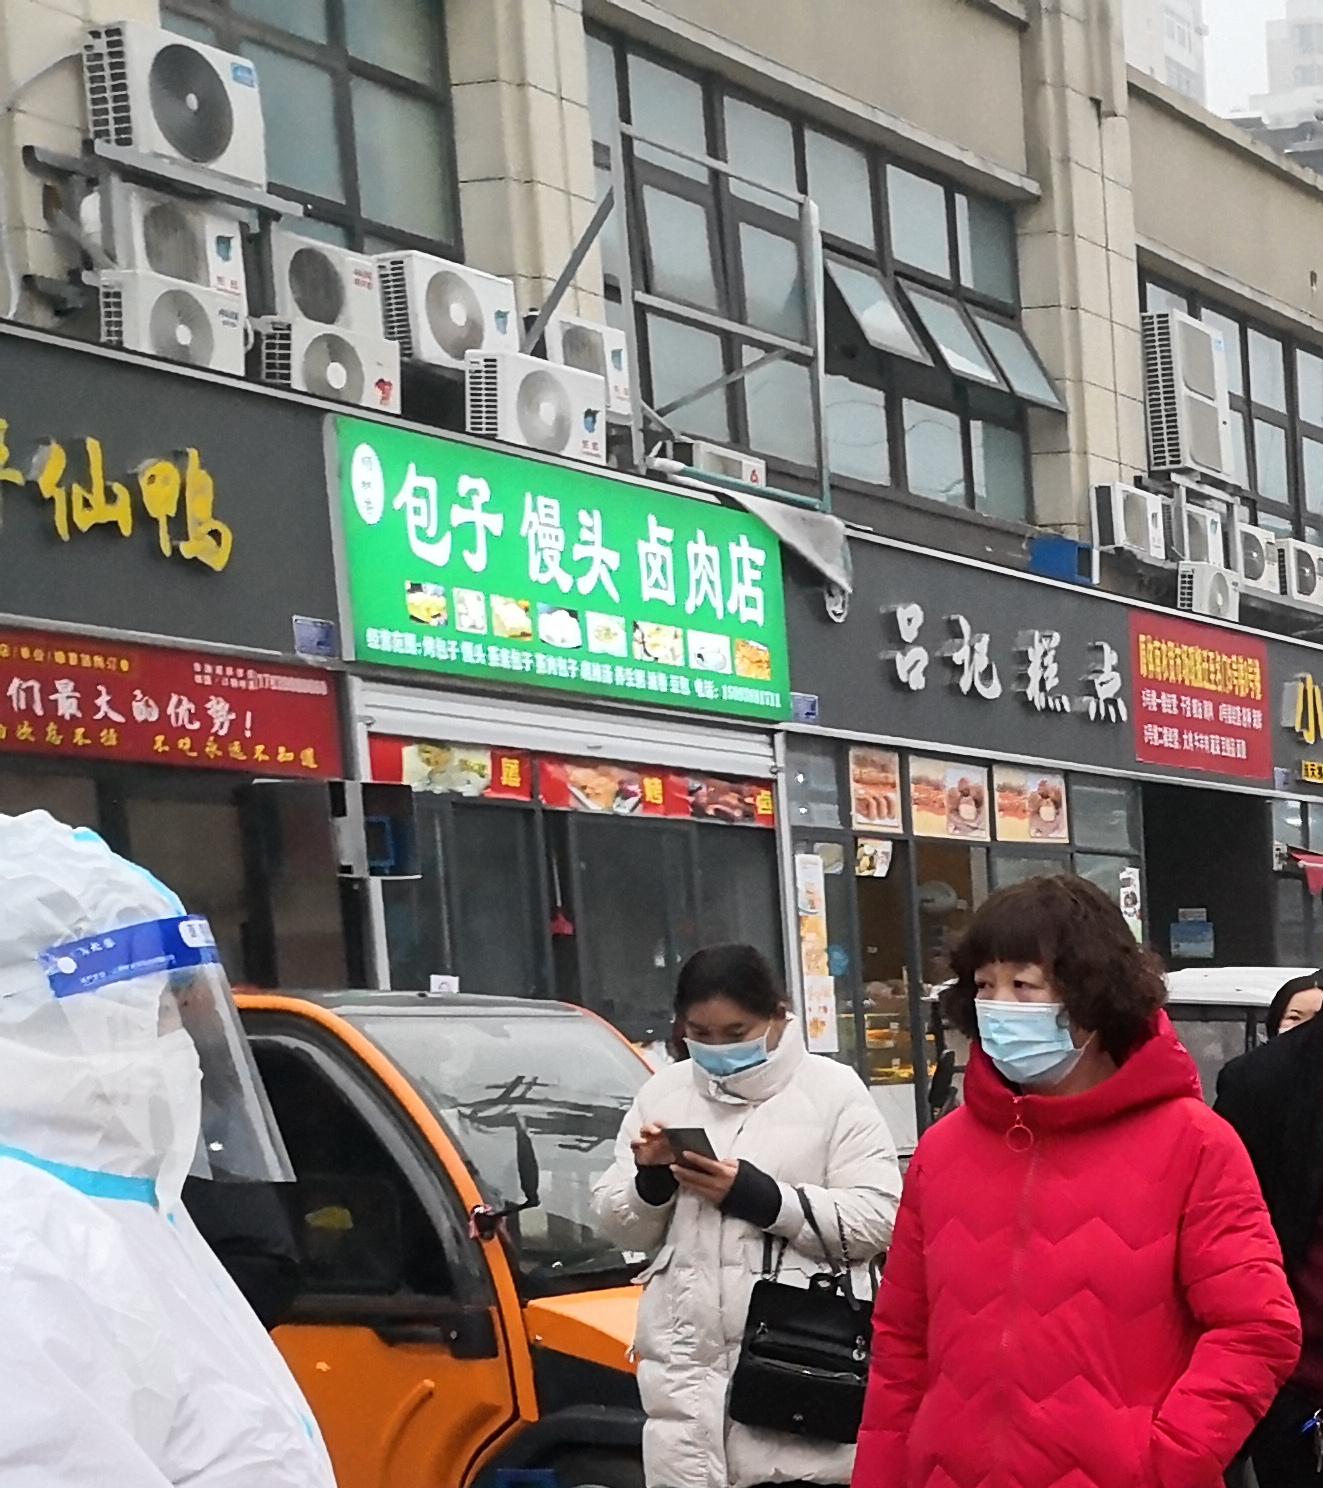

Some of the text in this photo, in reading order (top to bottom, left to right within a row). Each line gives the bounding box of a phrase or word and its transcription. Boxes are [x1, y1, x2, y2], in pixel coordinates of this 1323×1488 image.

[392, 462, 503, 572] 包子
[519, 491, 621, 603] 馒头
[636, 513, 767, 628] 卤肉店
[896, 602, 1128, 723] 吕记糕点
